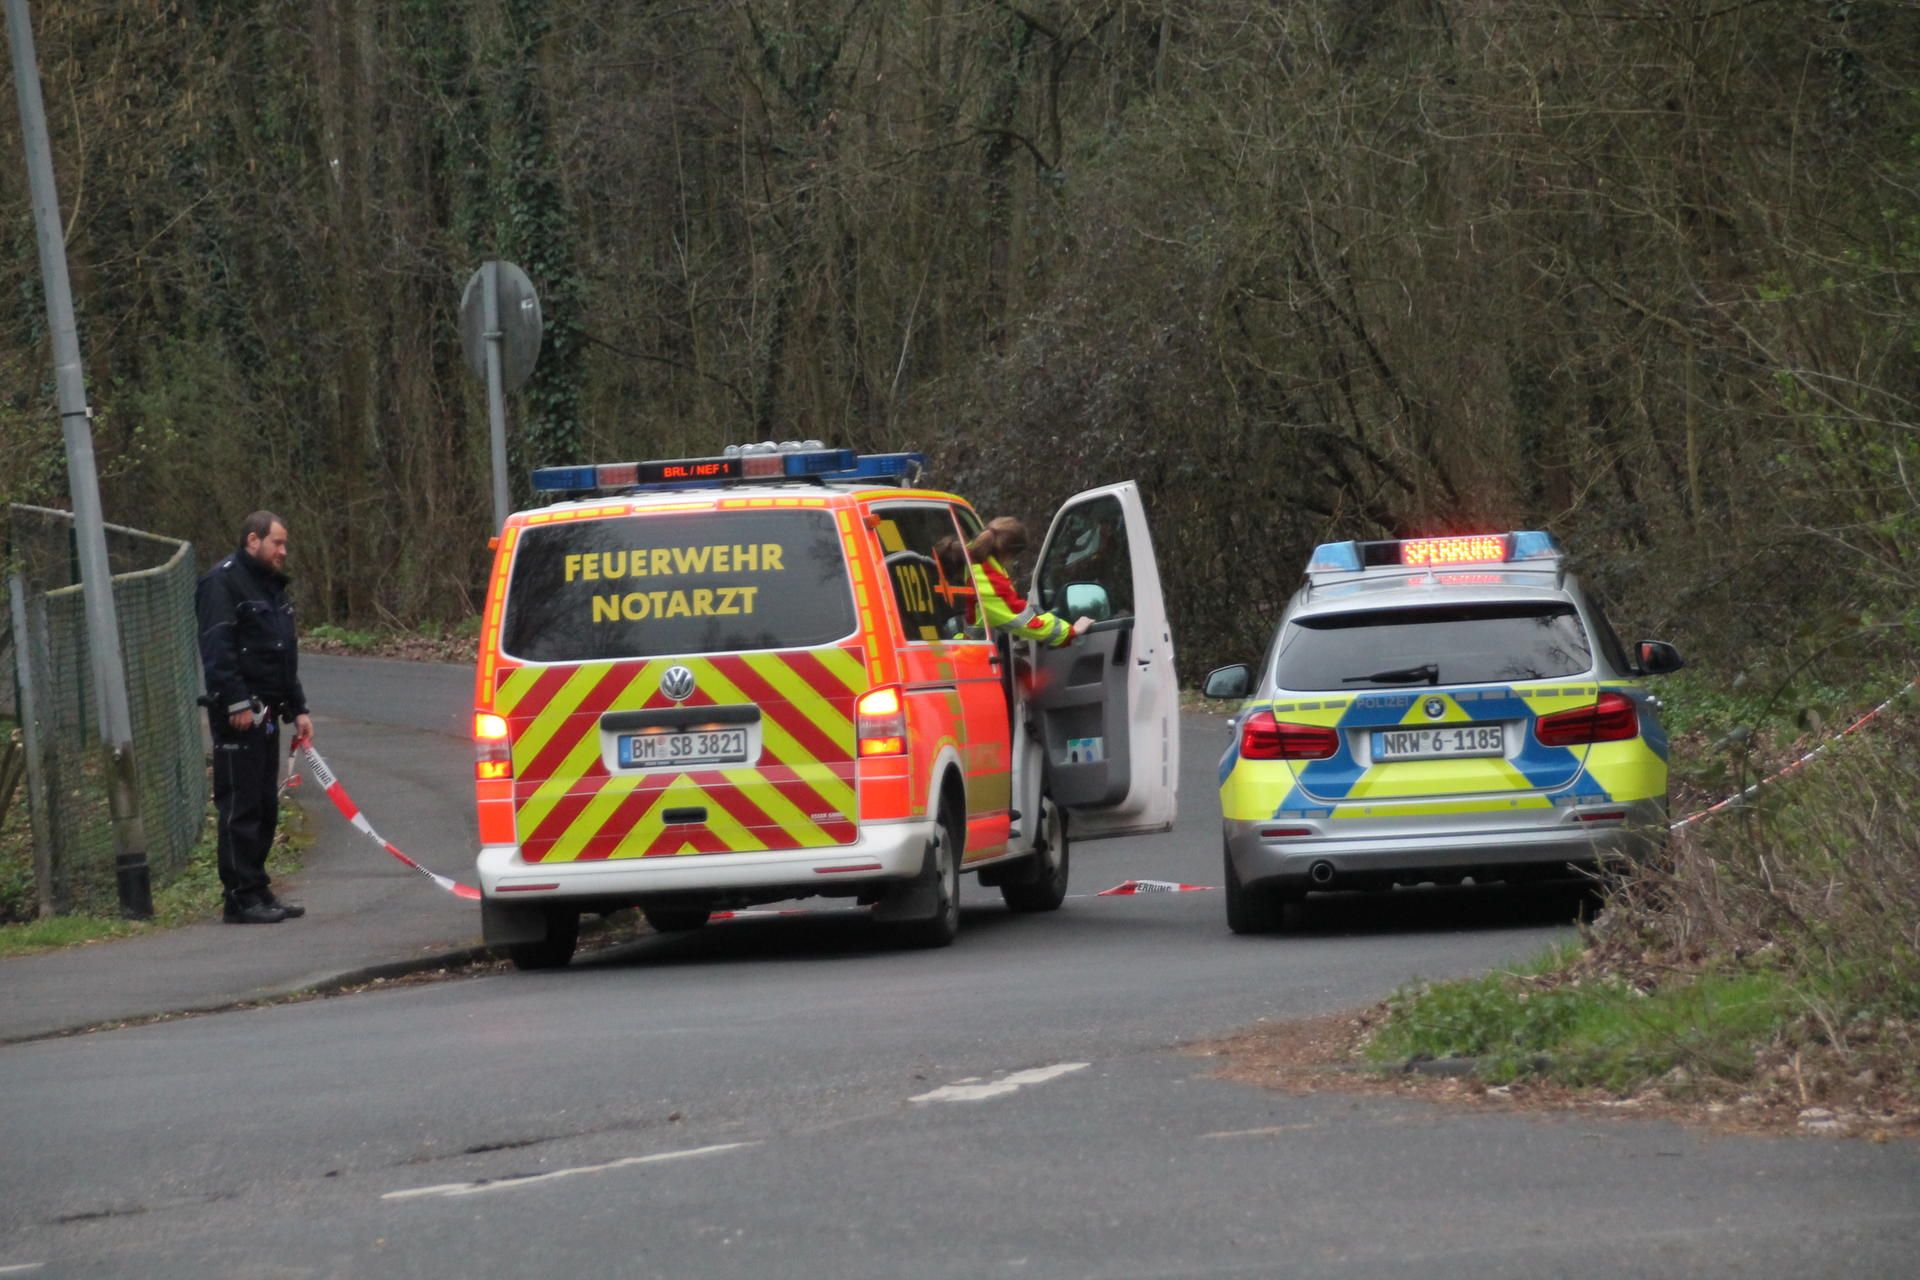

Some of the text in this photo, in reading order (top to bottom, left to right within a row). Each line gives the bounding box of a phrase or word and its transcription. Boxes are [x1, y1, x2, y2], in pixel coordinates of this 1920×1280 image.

[664, 466, 688, 478] BRL
[696, 463, 720, 475] NEF
[722, 463, 729, 473] 1
[565, 543, 784, 582] FEUERWEHR
[592, 586, 757, 622] NOTARZT
[1356, 694, 1409, 710] POLIZEI
[632, 732, 744, 759] BM SB 3821
[1383, 728, 1500, 755] NRW 6-1185
